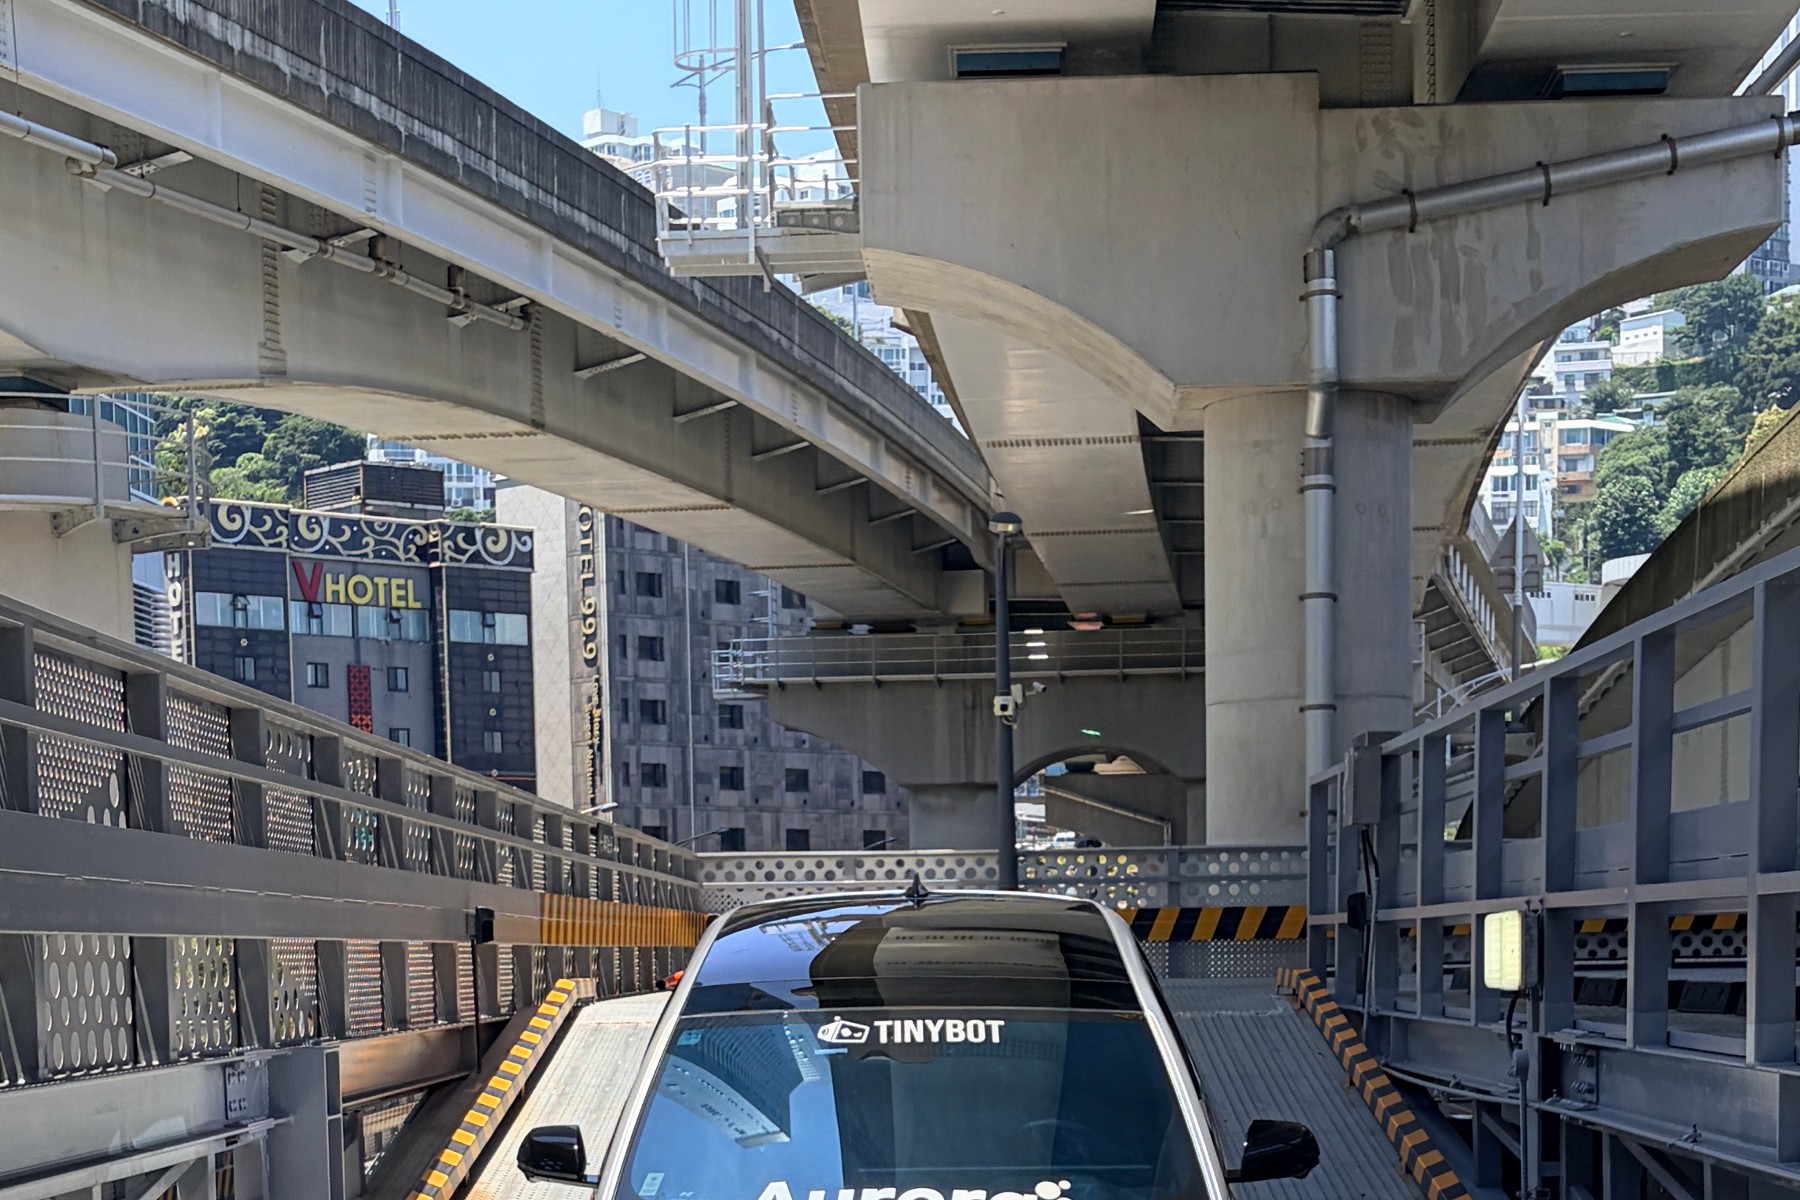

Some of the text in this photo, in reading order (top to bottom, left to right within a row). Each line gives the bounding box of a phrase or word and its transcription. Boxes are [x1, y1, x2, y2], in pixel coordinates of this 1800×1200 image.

[292, 561, 422, 609] V HOTEL
[873, 1019, 1005, 1044] TINYBOT
